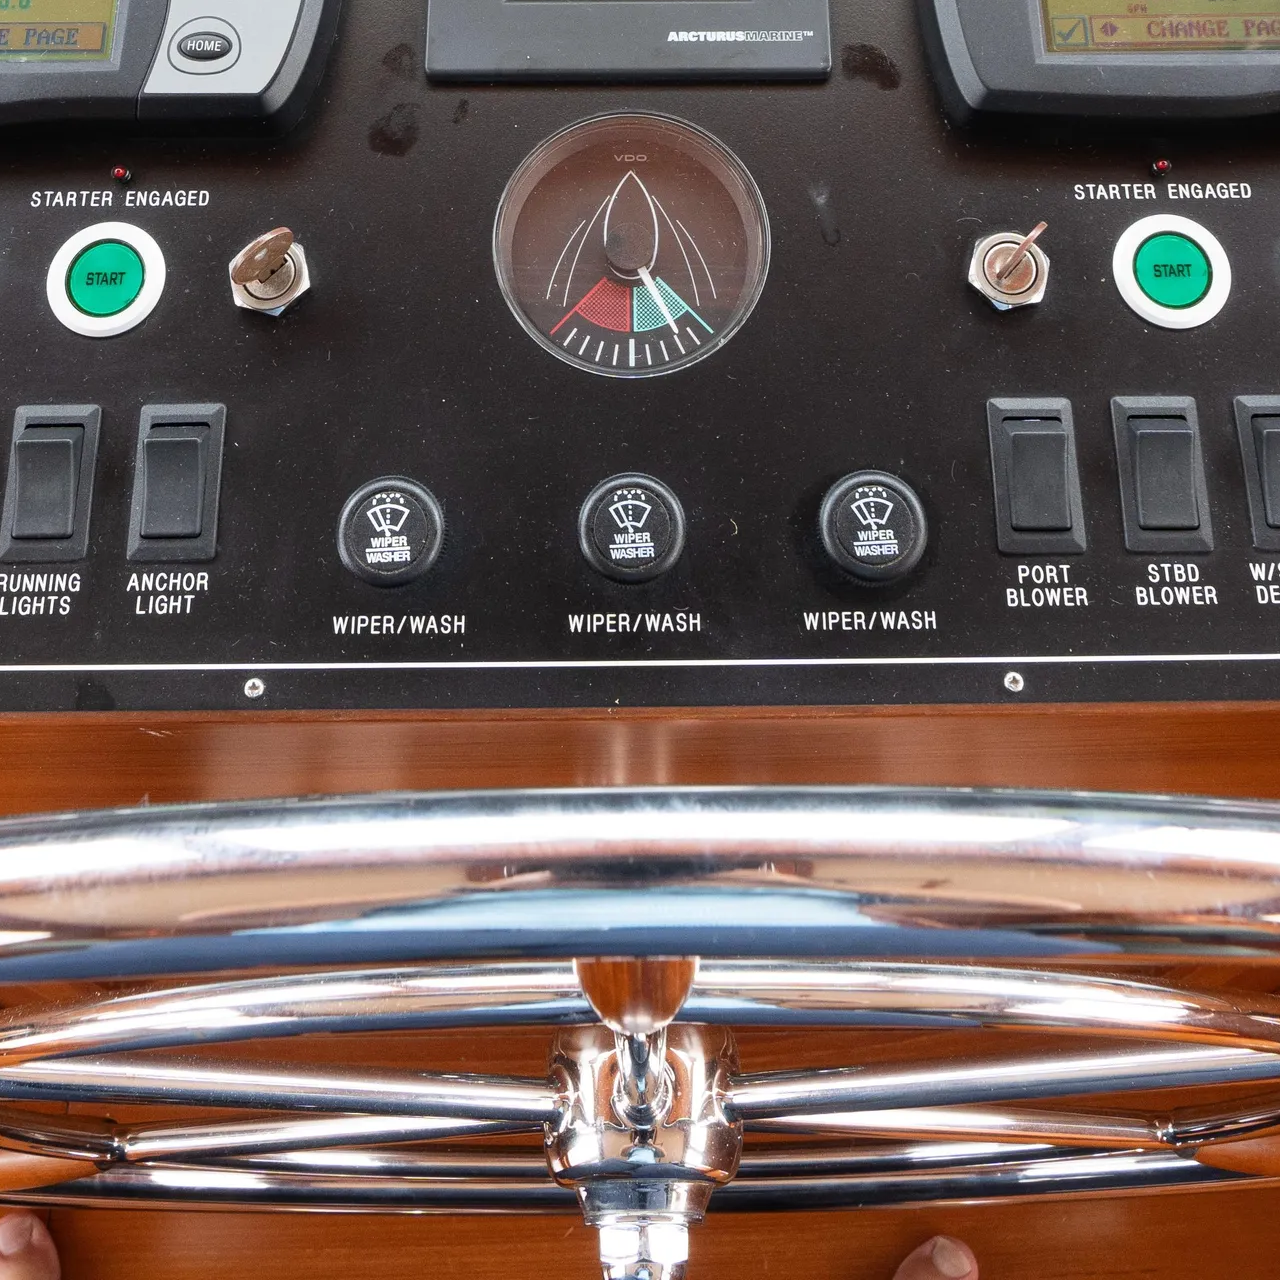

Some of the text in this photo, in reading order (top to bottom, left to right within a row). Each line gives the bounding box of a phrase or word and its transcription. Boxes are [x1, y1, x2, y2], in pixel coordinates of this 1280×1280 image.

[23, 28, 79, 46] PAGE
[1147, 20, 1230, 38] CHANGE
[187, 40, 222, 52] HOME
[614, 154, 648, 162] VDO
[30, 190, 210, 208] STARTER ENGAGED
[1074, 183, 1252, 200] STARTER ENGAGED
[85, 271, 126, 287] START
[1153, 263, 1192, 279] START
[370, 536, 408, 549] WIPER
[613, 533, 651, 545] WIPER
[857, 529, 894, 542] WIPER
[365, 550, 411, 564] WASHER
[610, 546, 655, 560] WASHER
[853, 544, 899, 557] WASHER
[127, 572, 209, 592] ANCHOR
[1018, 565, 1071, 584] PORT
[1148, 564, 1200, 583] STBD
[136, 595, 195, 614] LIGHT
[1006, 588, 1089, 607] BLOWER
[1135, 586, 1218, 606] BLOWER
[333, 616, 466, 635] WIPER/WASH
[568, 613, 701, 633] WIPER/WASH
[803, 611, 937, 631] WIPER/WASH
